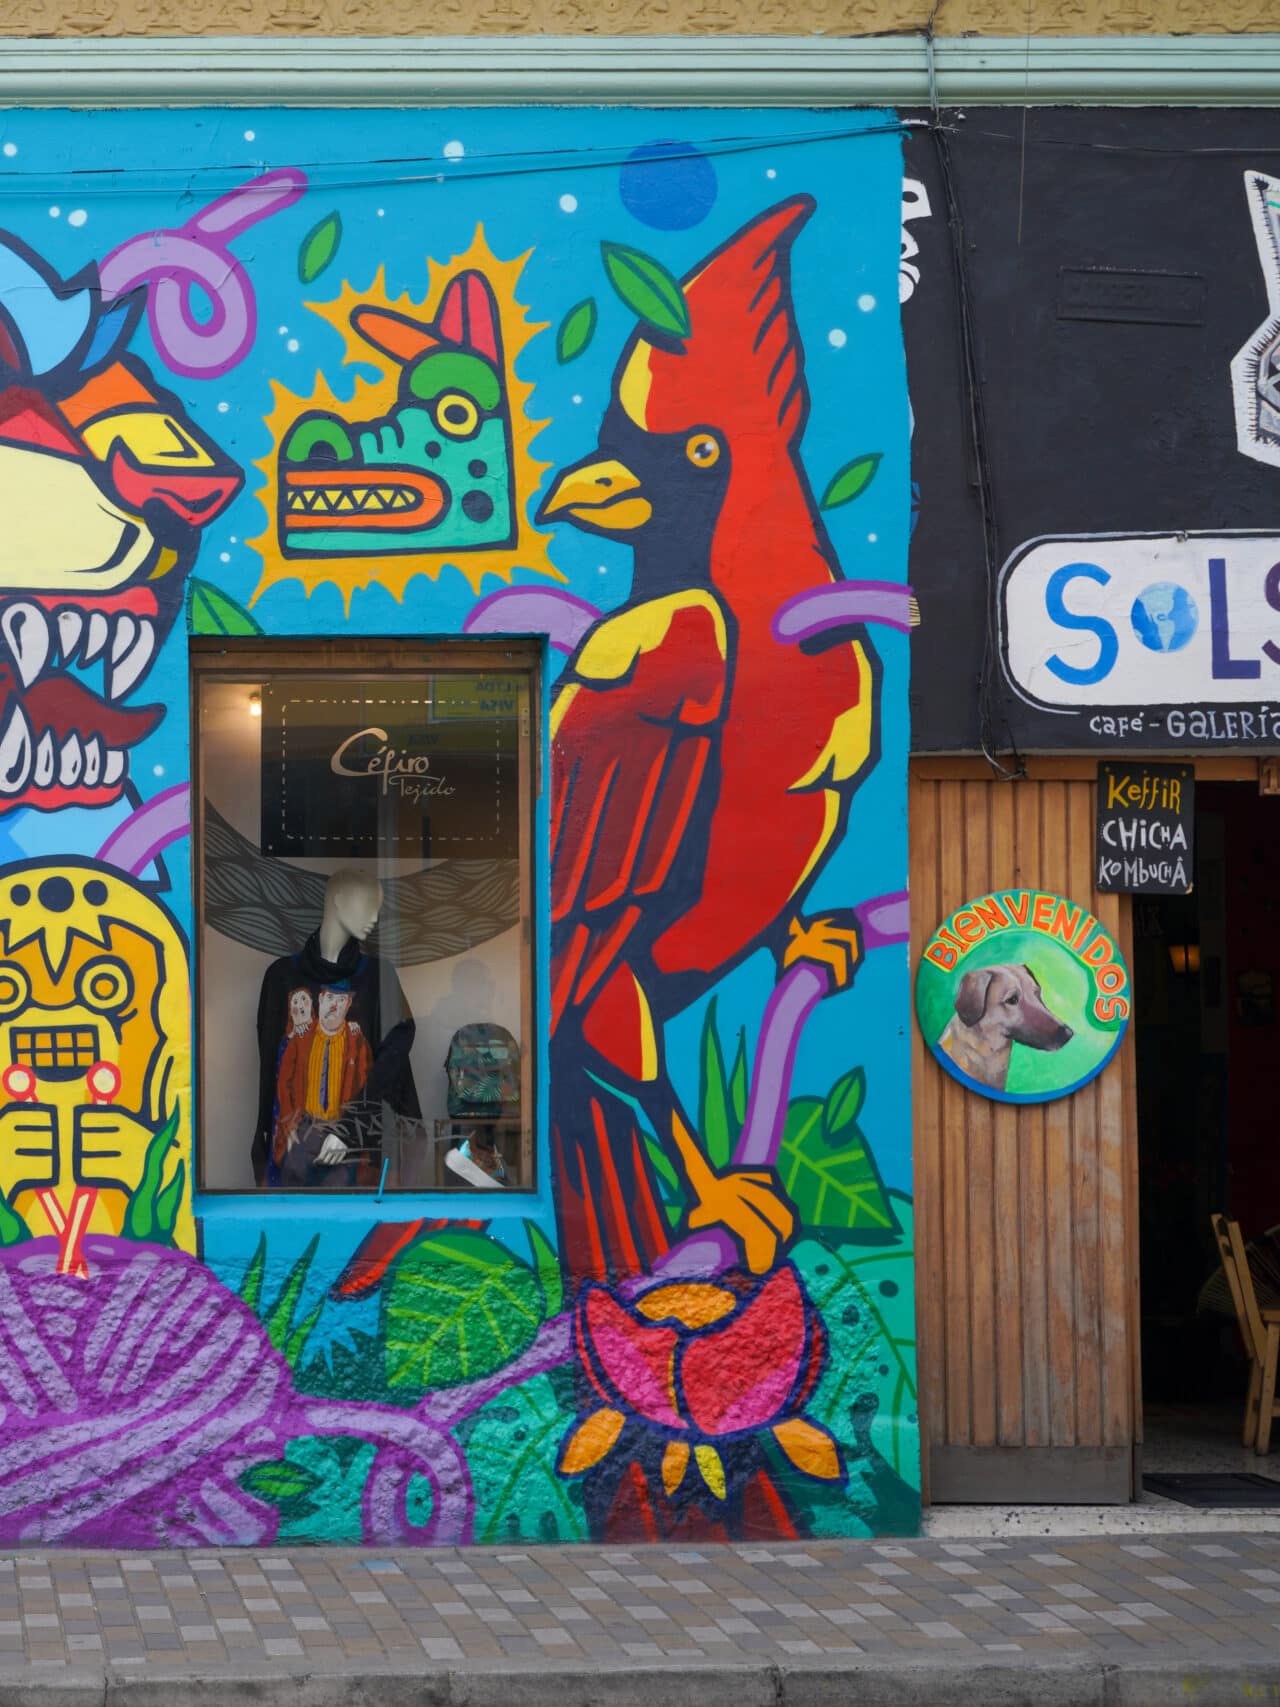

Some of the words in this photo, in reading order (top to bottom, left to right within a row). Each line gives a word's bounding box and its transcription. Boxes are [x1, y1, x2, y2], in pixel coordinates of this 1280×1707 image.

[1044, 558, 1280, 686] SOL
[1102, 817, 1188, 852] CHiCHA
[1107, 774, 1182, 815] KeffiR
[925, 892, 1129, 1022] BIeNVENiDOS
